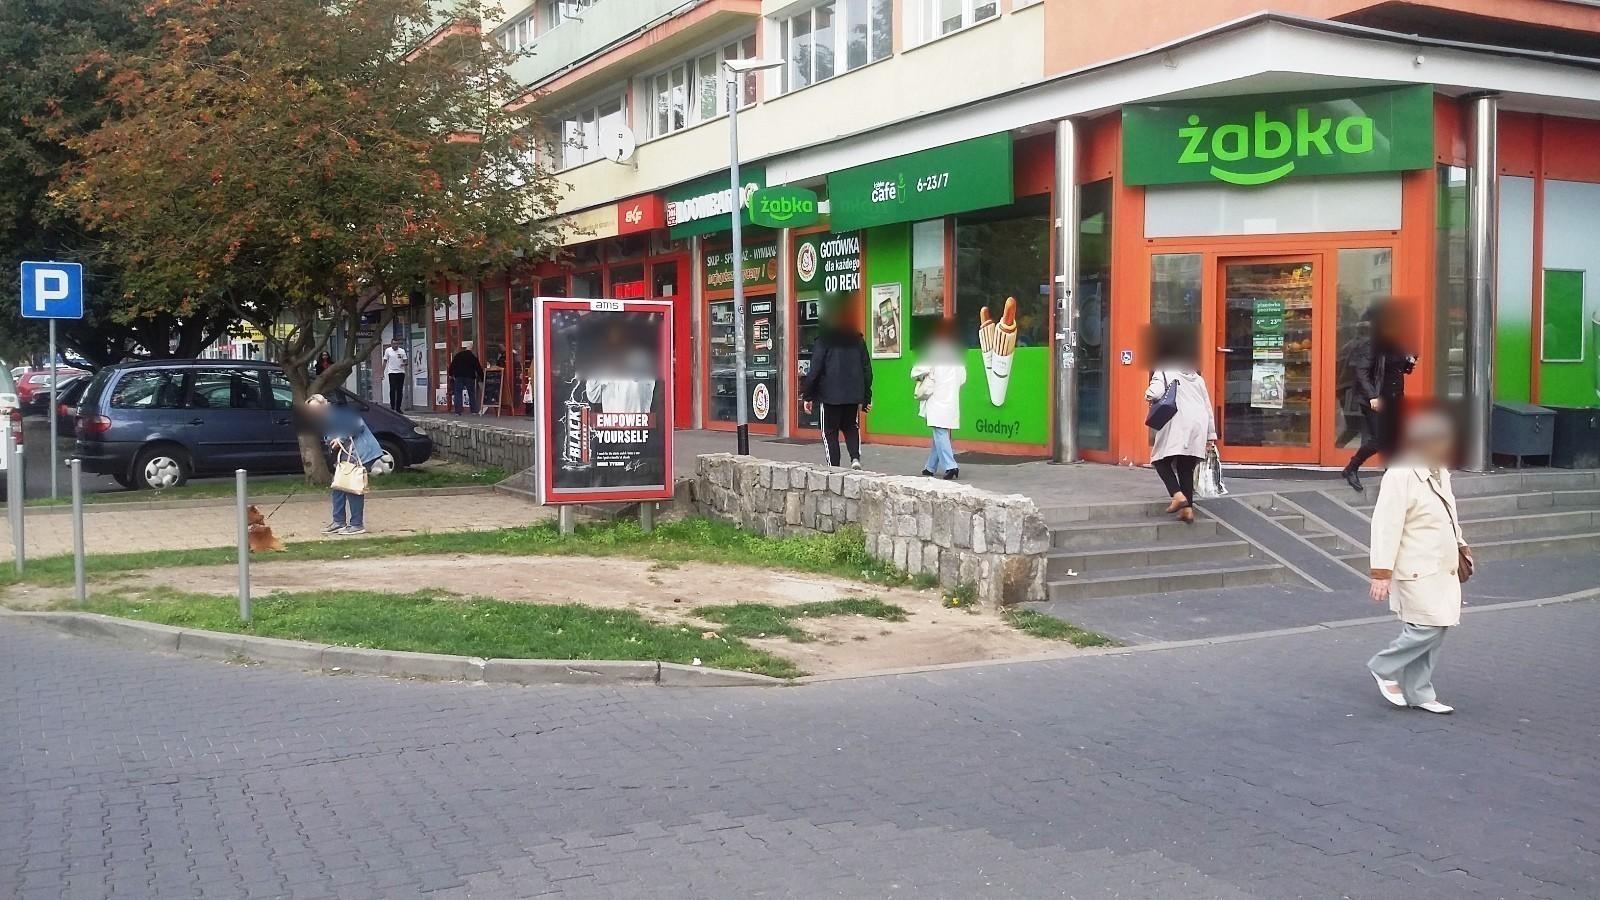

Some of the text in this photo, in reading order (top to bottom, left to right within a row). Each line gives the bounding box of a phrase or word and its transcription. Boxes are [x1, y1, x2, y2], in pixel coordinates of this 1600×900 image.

[1177, 108, 1375, 164] żabka
[916, 173, 949, 192] 6-23/7
[872, 182, 897, 203] café
[760, 196, 813, 213] żabka
[820, 235, 860, 258] GOTÓWKA
[825, 260, 834, 272] dla
[35, 269, 69, 311] P
[825, 273, 860, 292] OD RĘKI
[596, 413, 649, 427] EMPOWER
[975, 419, 1020, 438] Głodny?
[569, 409, 582, 459] BLACK
[596, 430, 649, 444] YOURSELF
